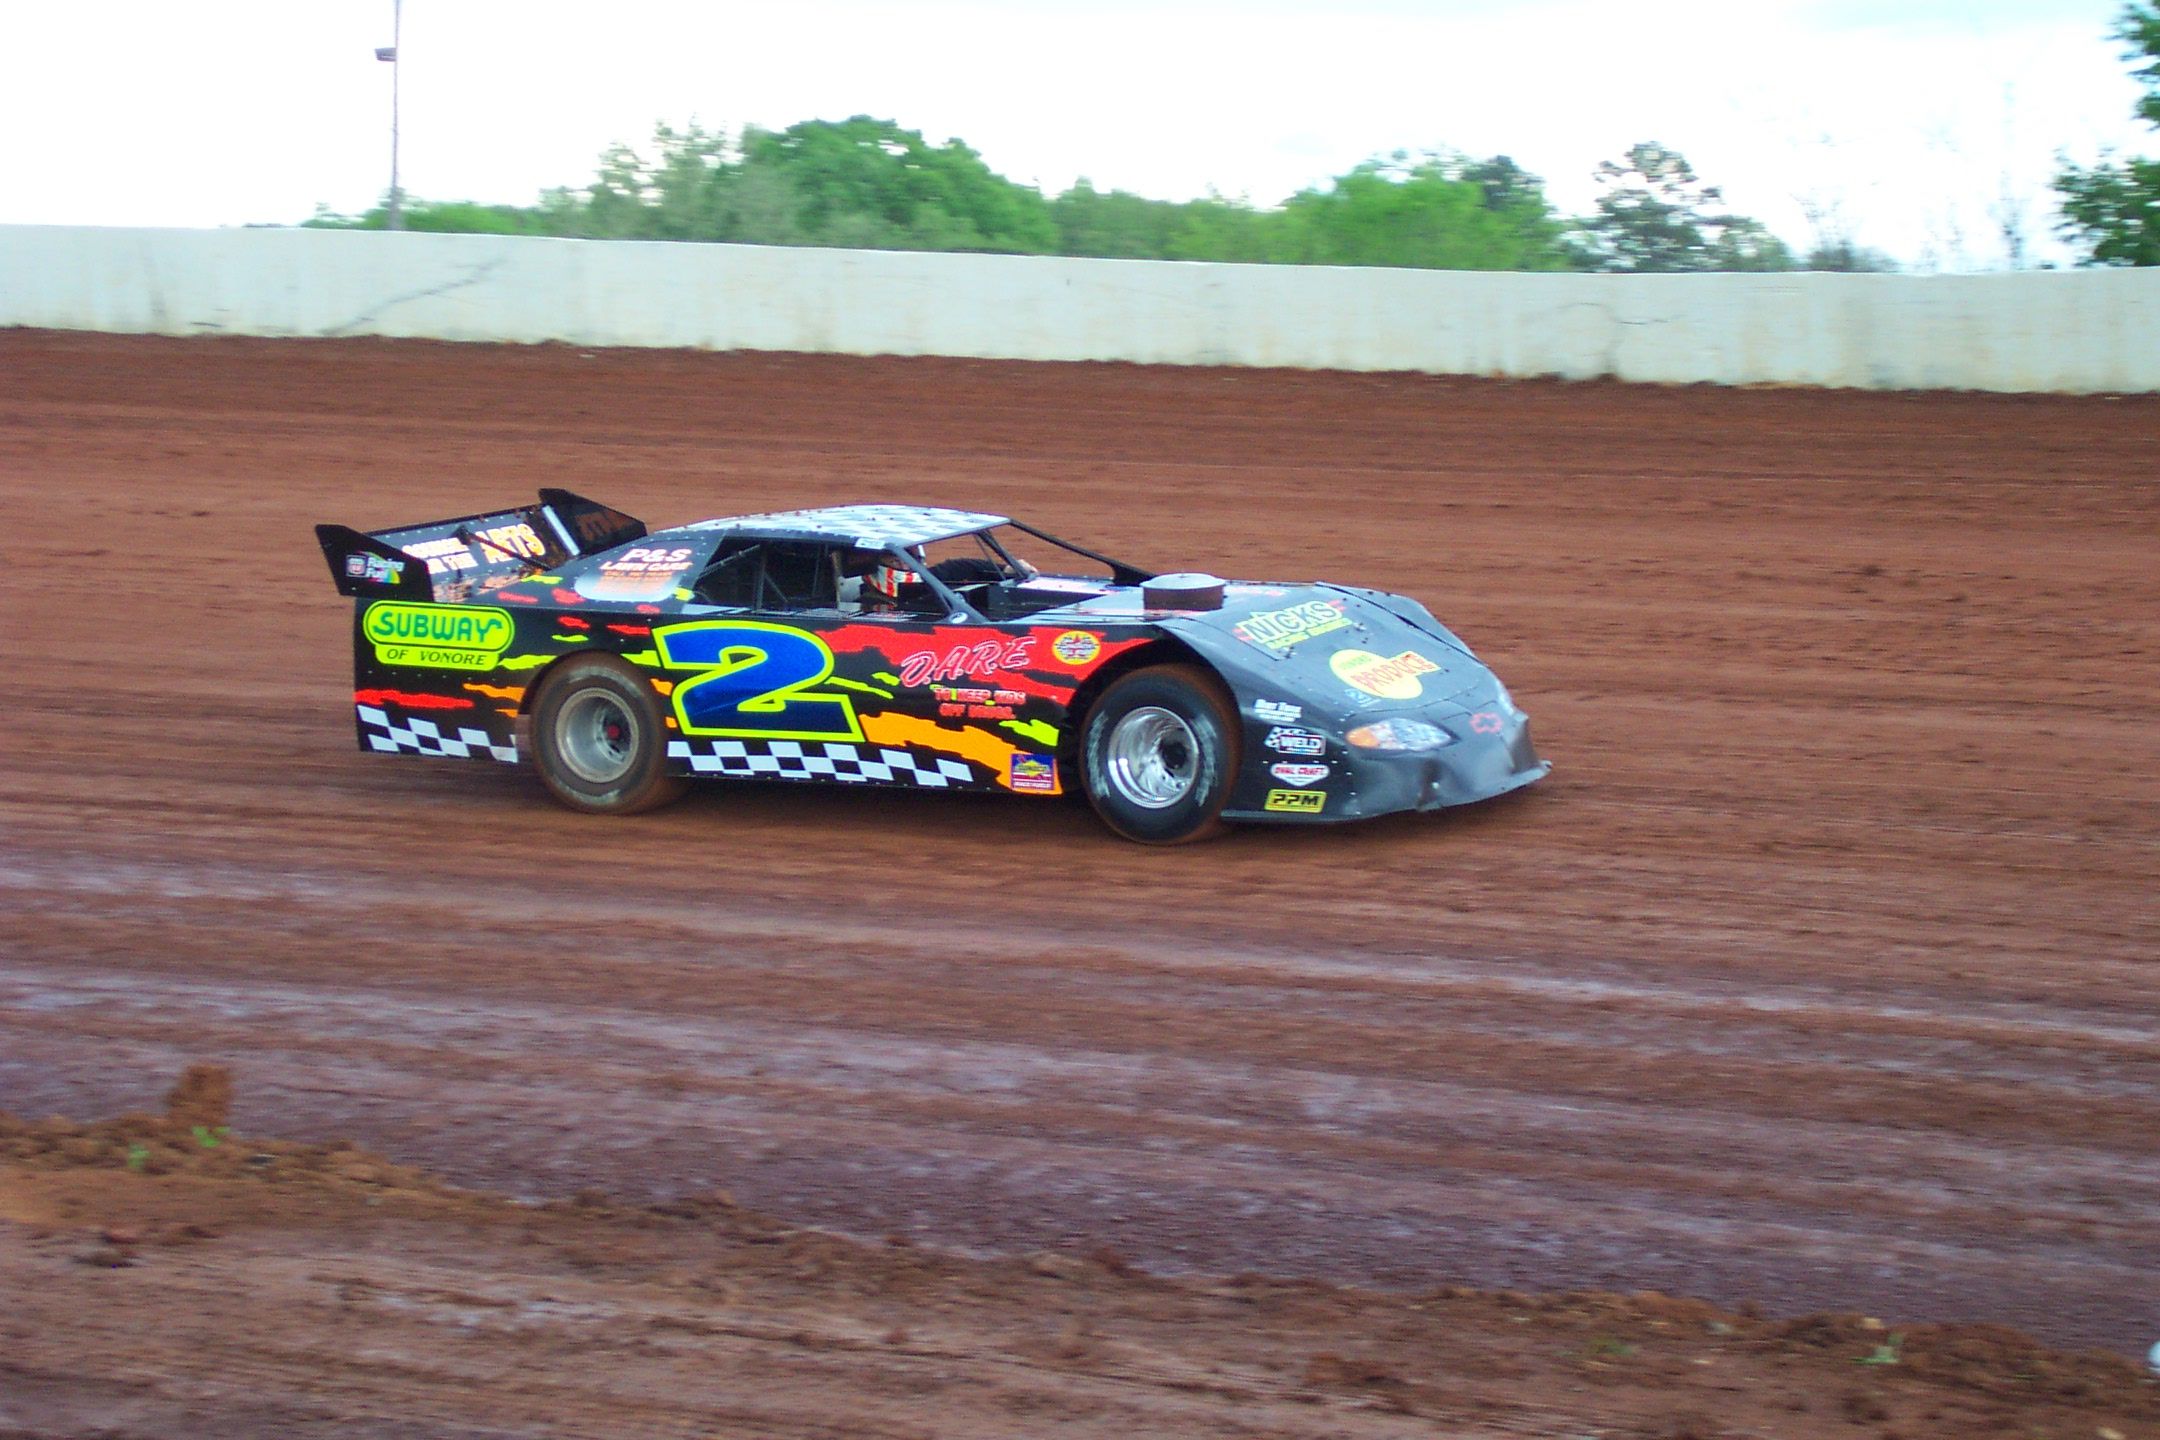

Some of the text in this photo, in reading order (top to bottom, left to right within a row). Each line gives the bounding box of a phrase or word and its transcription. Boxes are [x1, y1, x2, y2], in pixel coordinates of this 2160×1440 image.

[619, 548, 692, 562] P&S
[373, 611, 503, 643] SUBWAY
[386, 648, 487, 666] OF VONORE
[652, 619, 865, 742] 2
[1273, 793, 1319, 806] PPM
